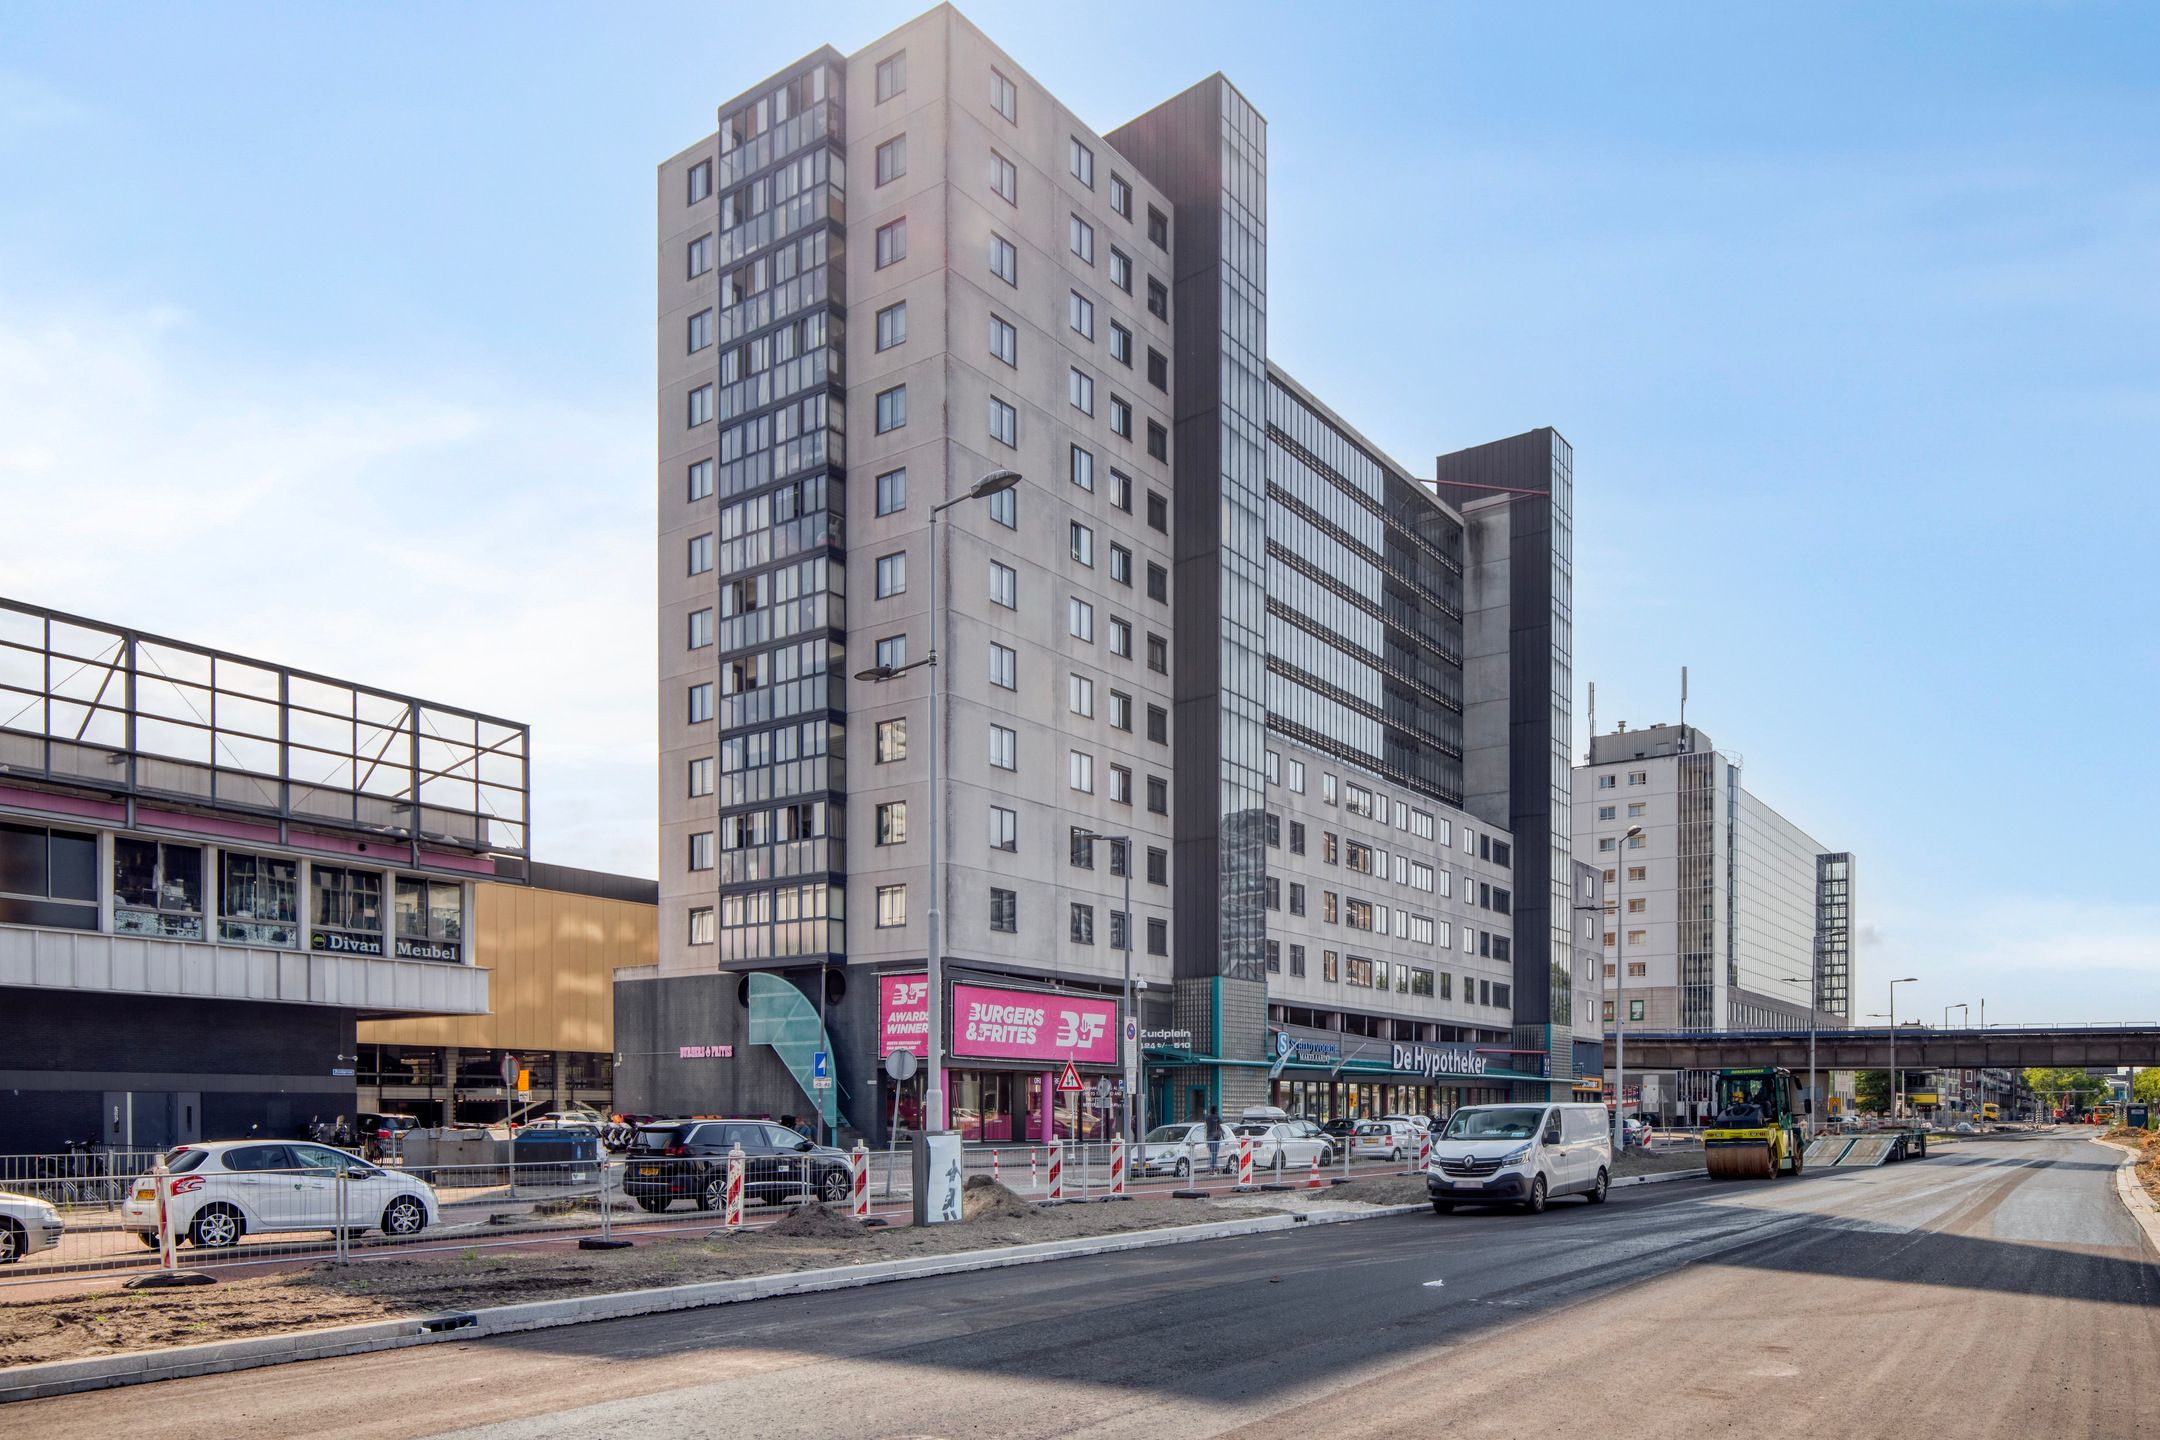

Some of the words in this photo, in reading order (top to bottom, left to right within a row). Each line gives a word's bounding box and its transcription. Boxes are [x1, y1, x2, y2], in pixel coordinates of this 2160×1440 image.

[330, 935, 380, 953] Divan
[397, 942, 456, 960] Meubel
[968, 1002, 1044, 1026] BURGERS
[1140, 1029, 1191, 1040] Zuidplein
[1393, 1044, 1412, 1070] De
[1414, 1046, 1487, 1078] Hypotheker
